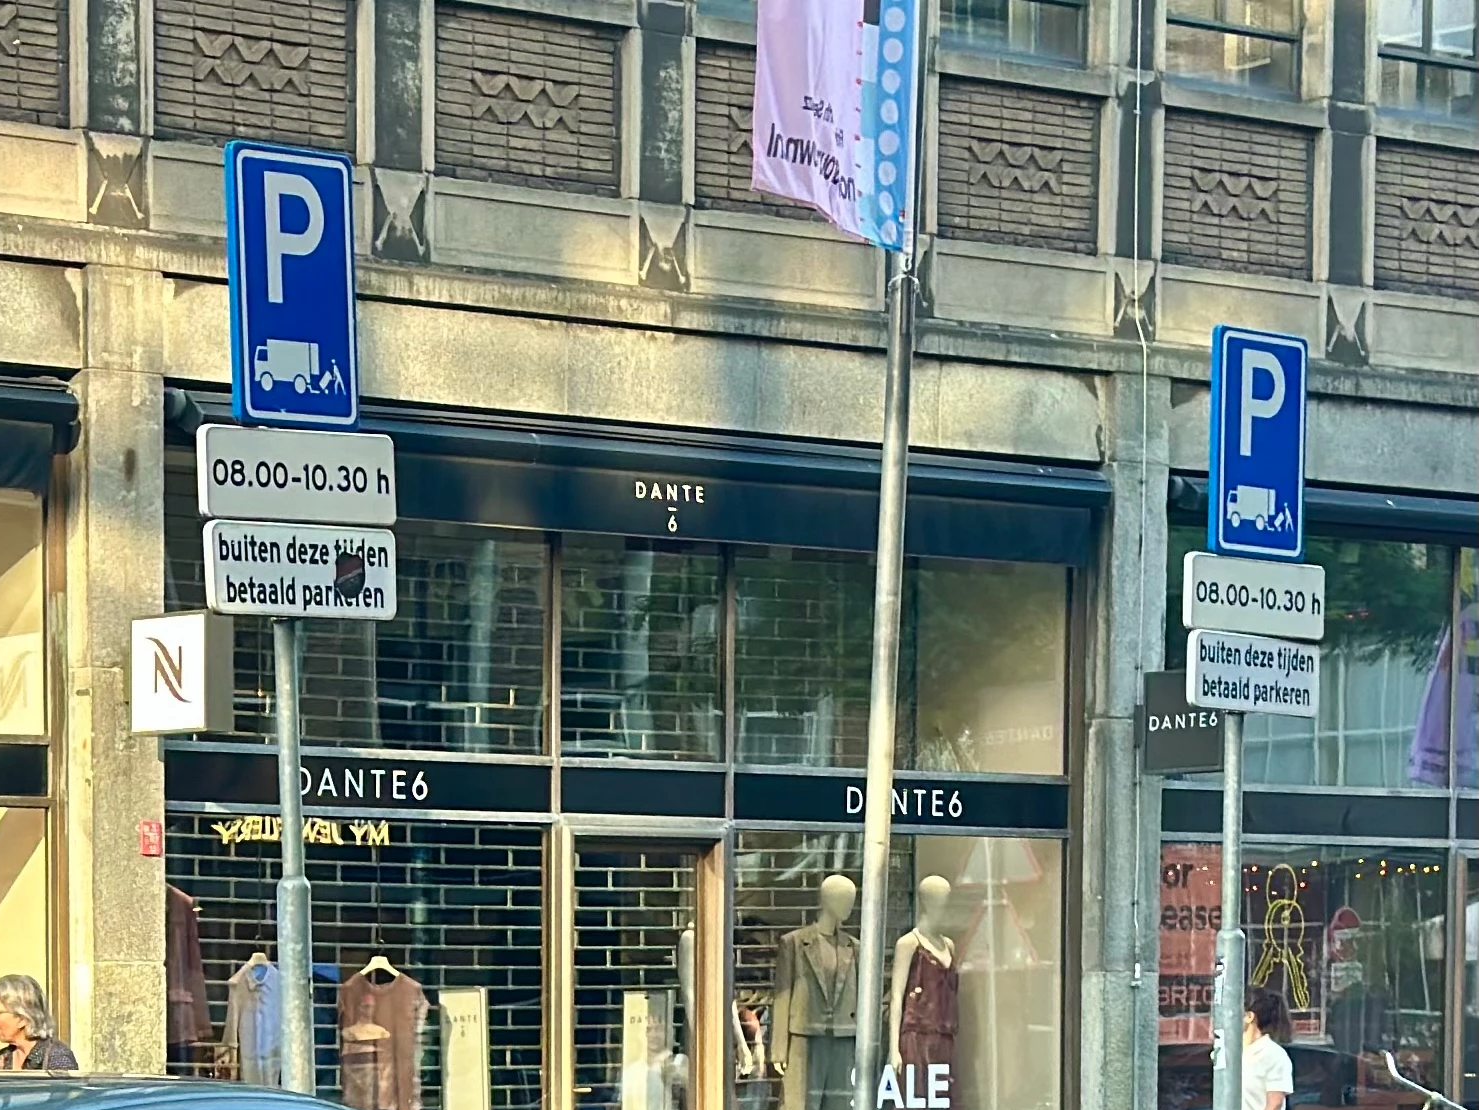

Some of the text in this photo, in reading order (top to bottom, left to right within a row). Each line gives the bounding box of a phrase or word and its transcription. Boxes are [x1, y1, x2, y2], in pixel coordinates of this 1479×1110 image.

[264, 171, 324, 303] P
[1240, 348, 1286, 457] P
[213, 458, 390, 494] 08.00-10.30 h
[635, 481, 704, 503] DANTE
[218, 532, 280, 563] buiten
[286, 535, 329, 565] deze
[226, 575, 296, 605] betaald
[1196, 580, 1320, 615] 08.00-10.30 h
[145, 637, 192, 703] N
[1200, 639, 1314, 677] buiten deze tijden
[1202, 673, 1310, 706] betaald parkeren
[1149, 711, 1218, 732] DANTE6
[846, 786, 962, 818] DNTE6
[850, 1064, 950, 1109] ALE
